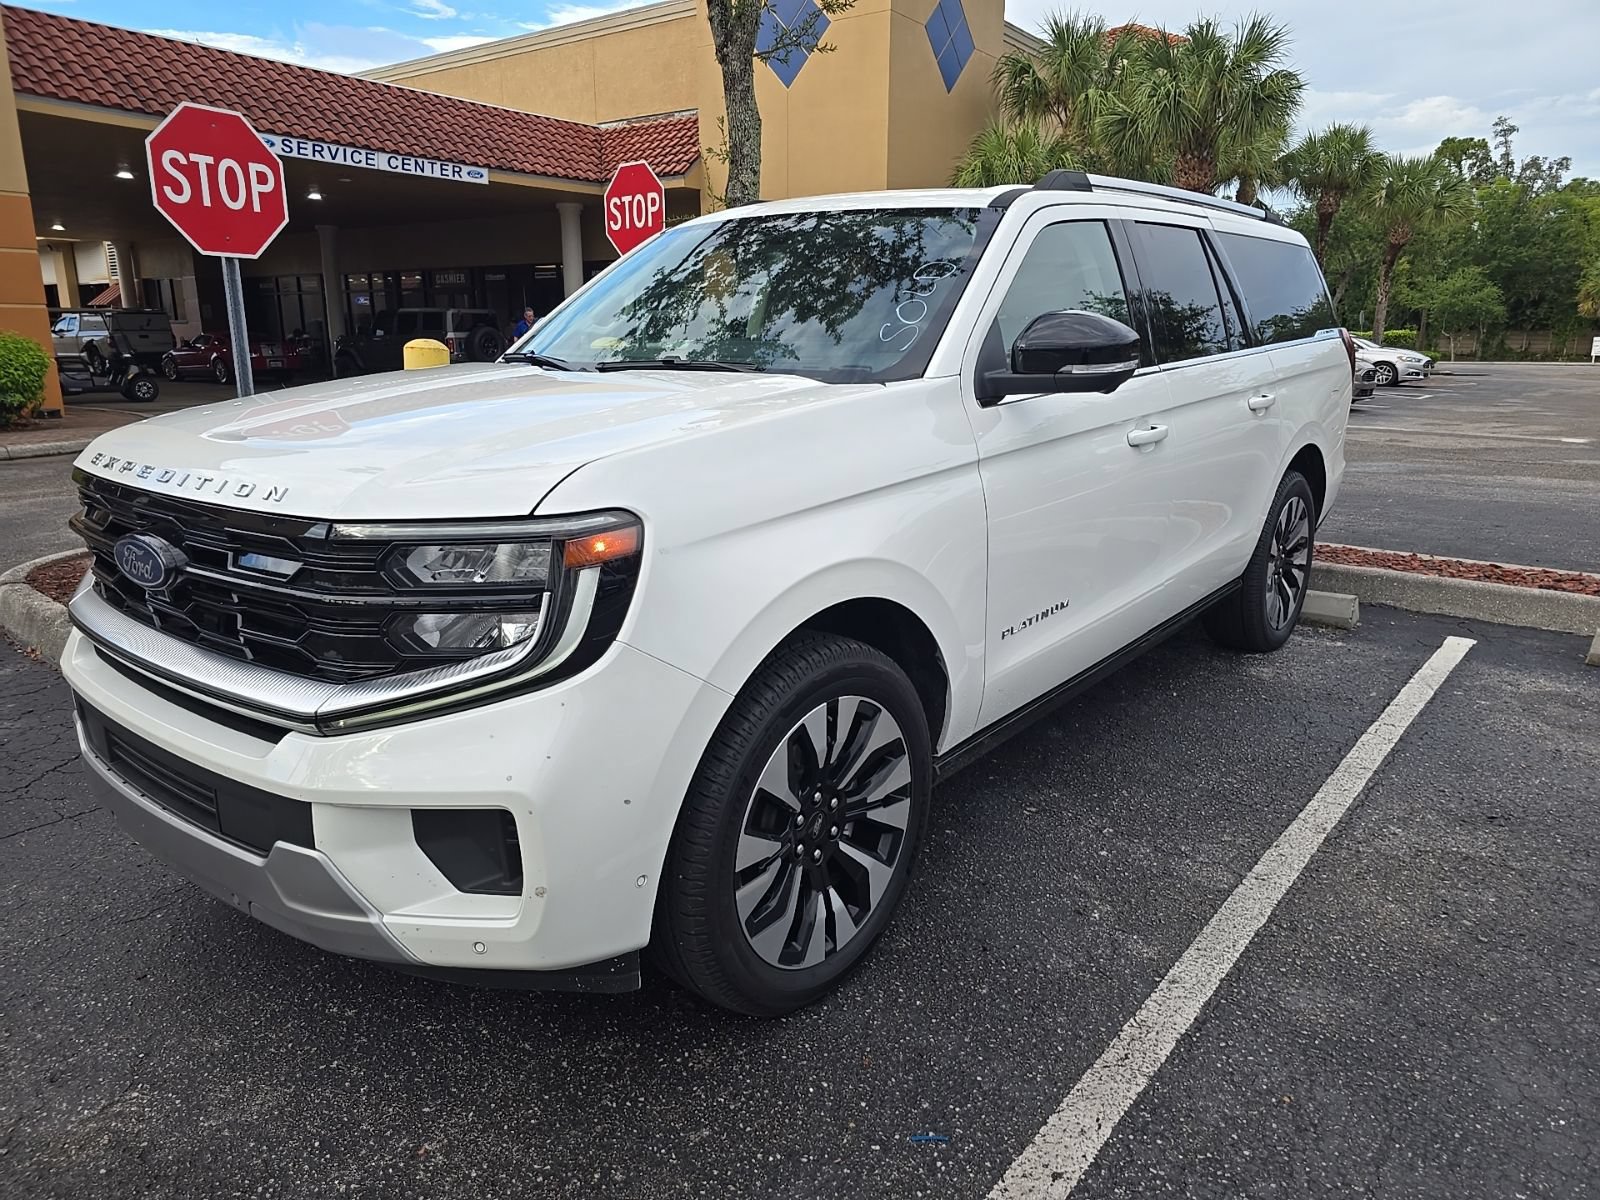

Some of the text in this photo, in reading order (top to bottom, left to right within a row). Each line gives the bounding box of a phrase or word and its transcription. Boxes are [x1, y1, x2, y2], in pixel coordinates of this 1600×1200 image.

[281, 138, 376, 167] SERVICE
[387, 155, 463, 179] CENTER
[161, 149, 275, 213] STOP
[609, 192, 660, 231] STOP
[880, 261, 957, 351] SOLD
[91, 452, 289, 503] EXPEDITION
[122, 544, 154, 580] Ford
[1001, 598, 1069, 640] PLATINUM
